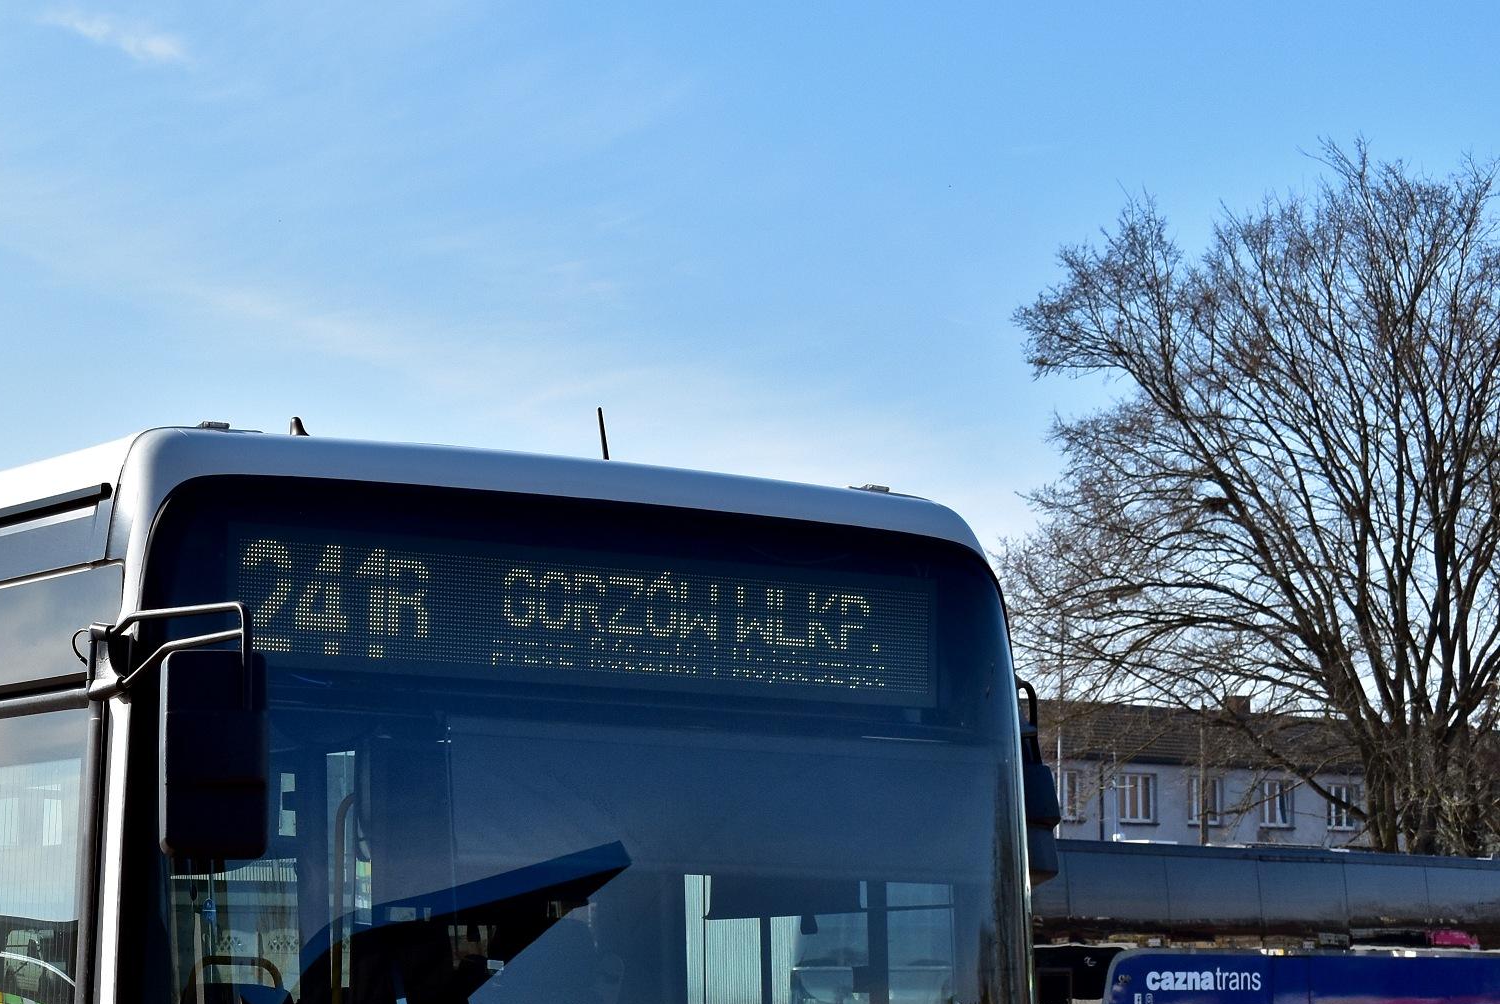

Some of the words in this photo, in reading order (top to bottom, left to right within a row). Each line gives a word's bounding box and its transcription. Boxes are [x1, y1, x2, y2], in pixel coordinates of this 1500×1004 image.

[242, 539, 430, 658] 241R
[503, 571, 718, 641] GORZÓW
[736, 585, 879, 652] WLKP.
[1146, 967, 1261, 991] caznatrans
